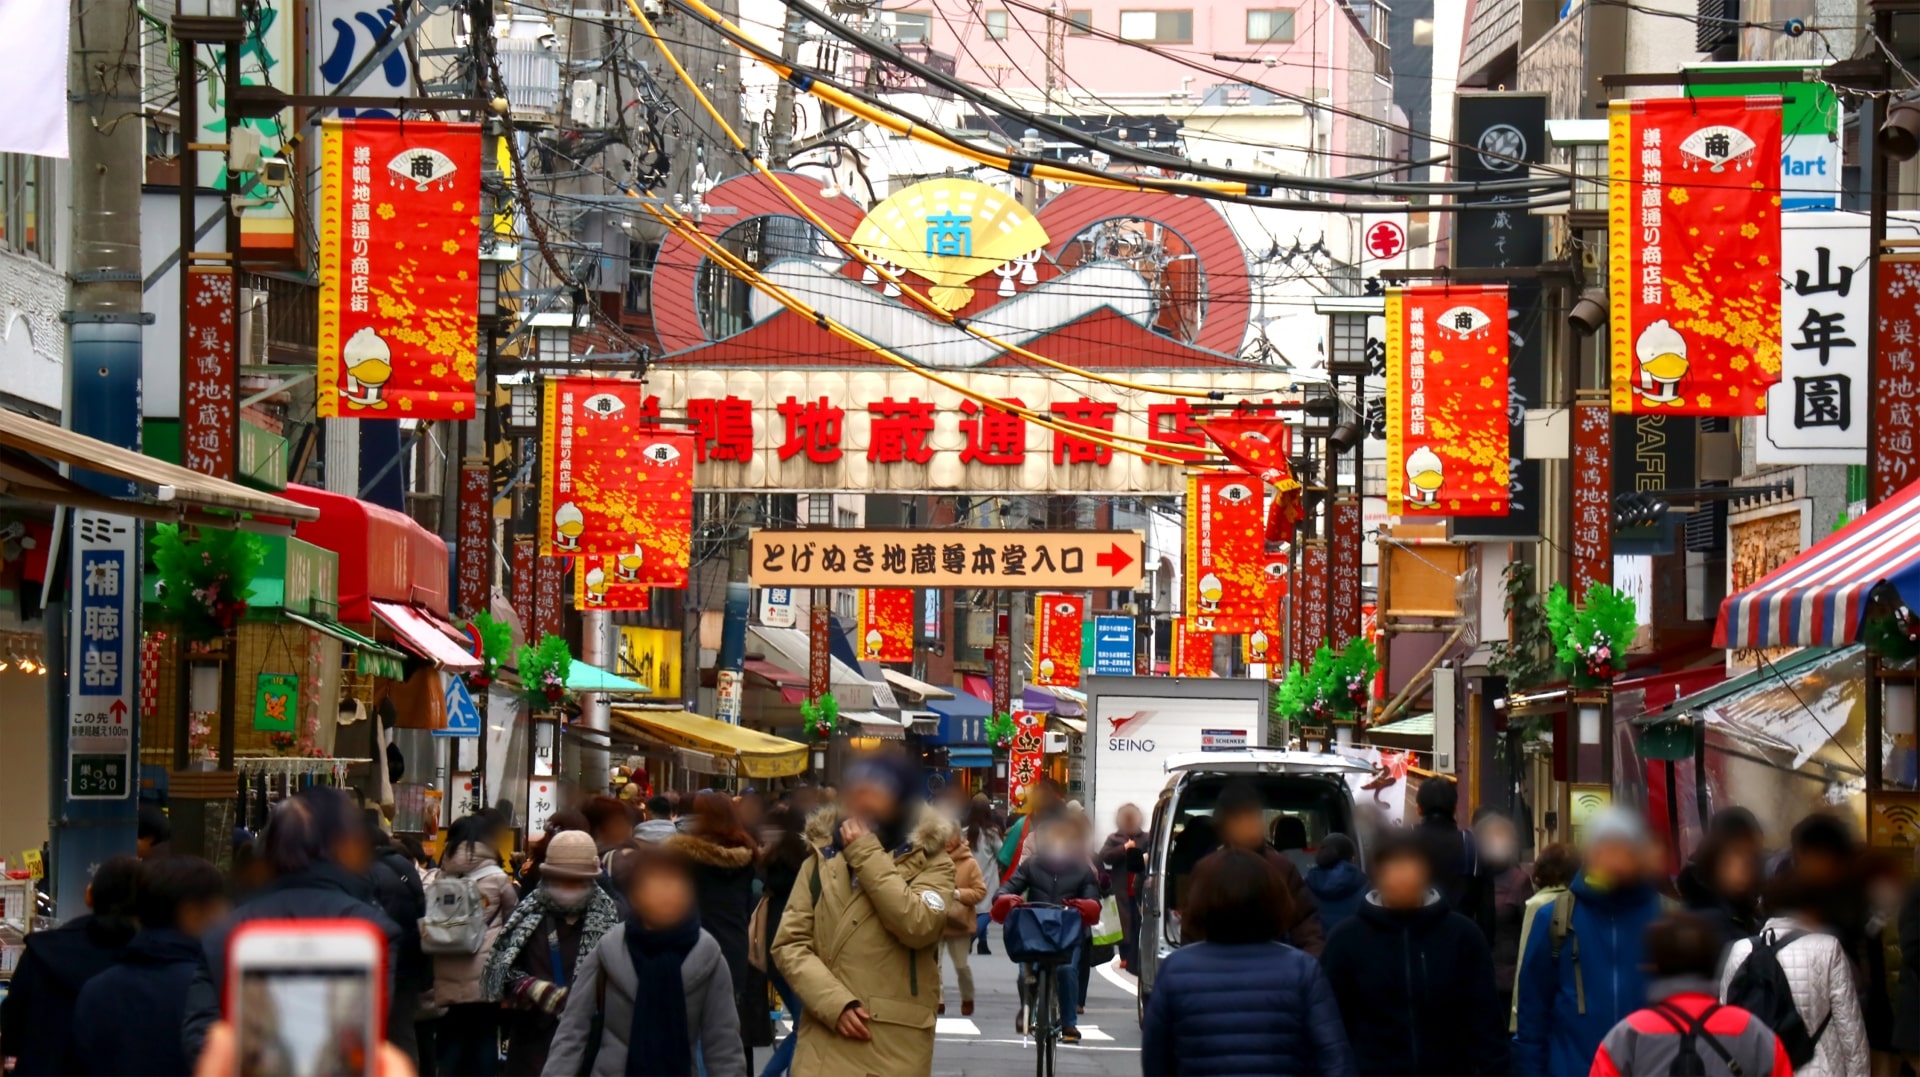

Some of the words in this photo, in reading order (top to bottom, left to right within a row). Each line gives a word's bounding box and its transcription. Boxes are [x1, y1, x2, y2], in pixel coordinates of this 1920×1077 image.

[411, 155, 434, 178] 商
[1704, 134, 1730, 158] 商
[350, 146, 371, 312] 巣鴨地蔵通り商店街
[925, 210, 973, 258] 商
[1641, 128, 1662, 305] 巣鴨地蔵通り商店街
[1454, 312, 1472, 330] 商
[1790, 247, 1857, 432] 山年園
[1410, 307, 1425, 435] 巣鴨地蔵通り商店街
[1887, 318, 1915, 481] 巣鴨地蔵通り
[196, 326, 222, 477] 巣鴨地蔵通り
[641, 394, 1292, 467] 鴨地蔵通商店
[81, 518, 126, 543] ミミー
[1582, 447, 1601, 563] 巣鴨地蔵通り
[763, 542, 1084, 575] とげぬき地蔵尊本堂入口
[84, 560, 120, 687] 補聴器
[74, 713, 108, 724] この先
[1109, 739, 1155, 752] SEINO
[80, 778, 117, 790] 3-20
